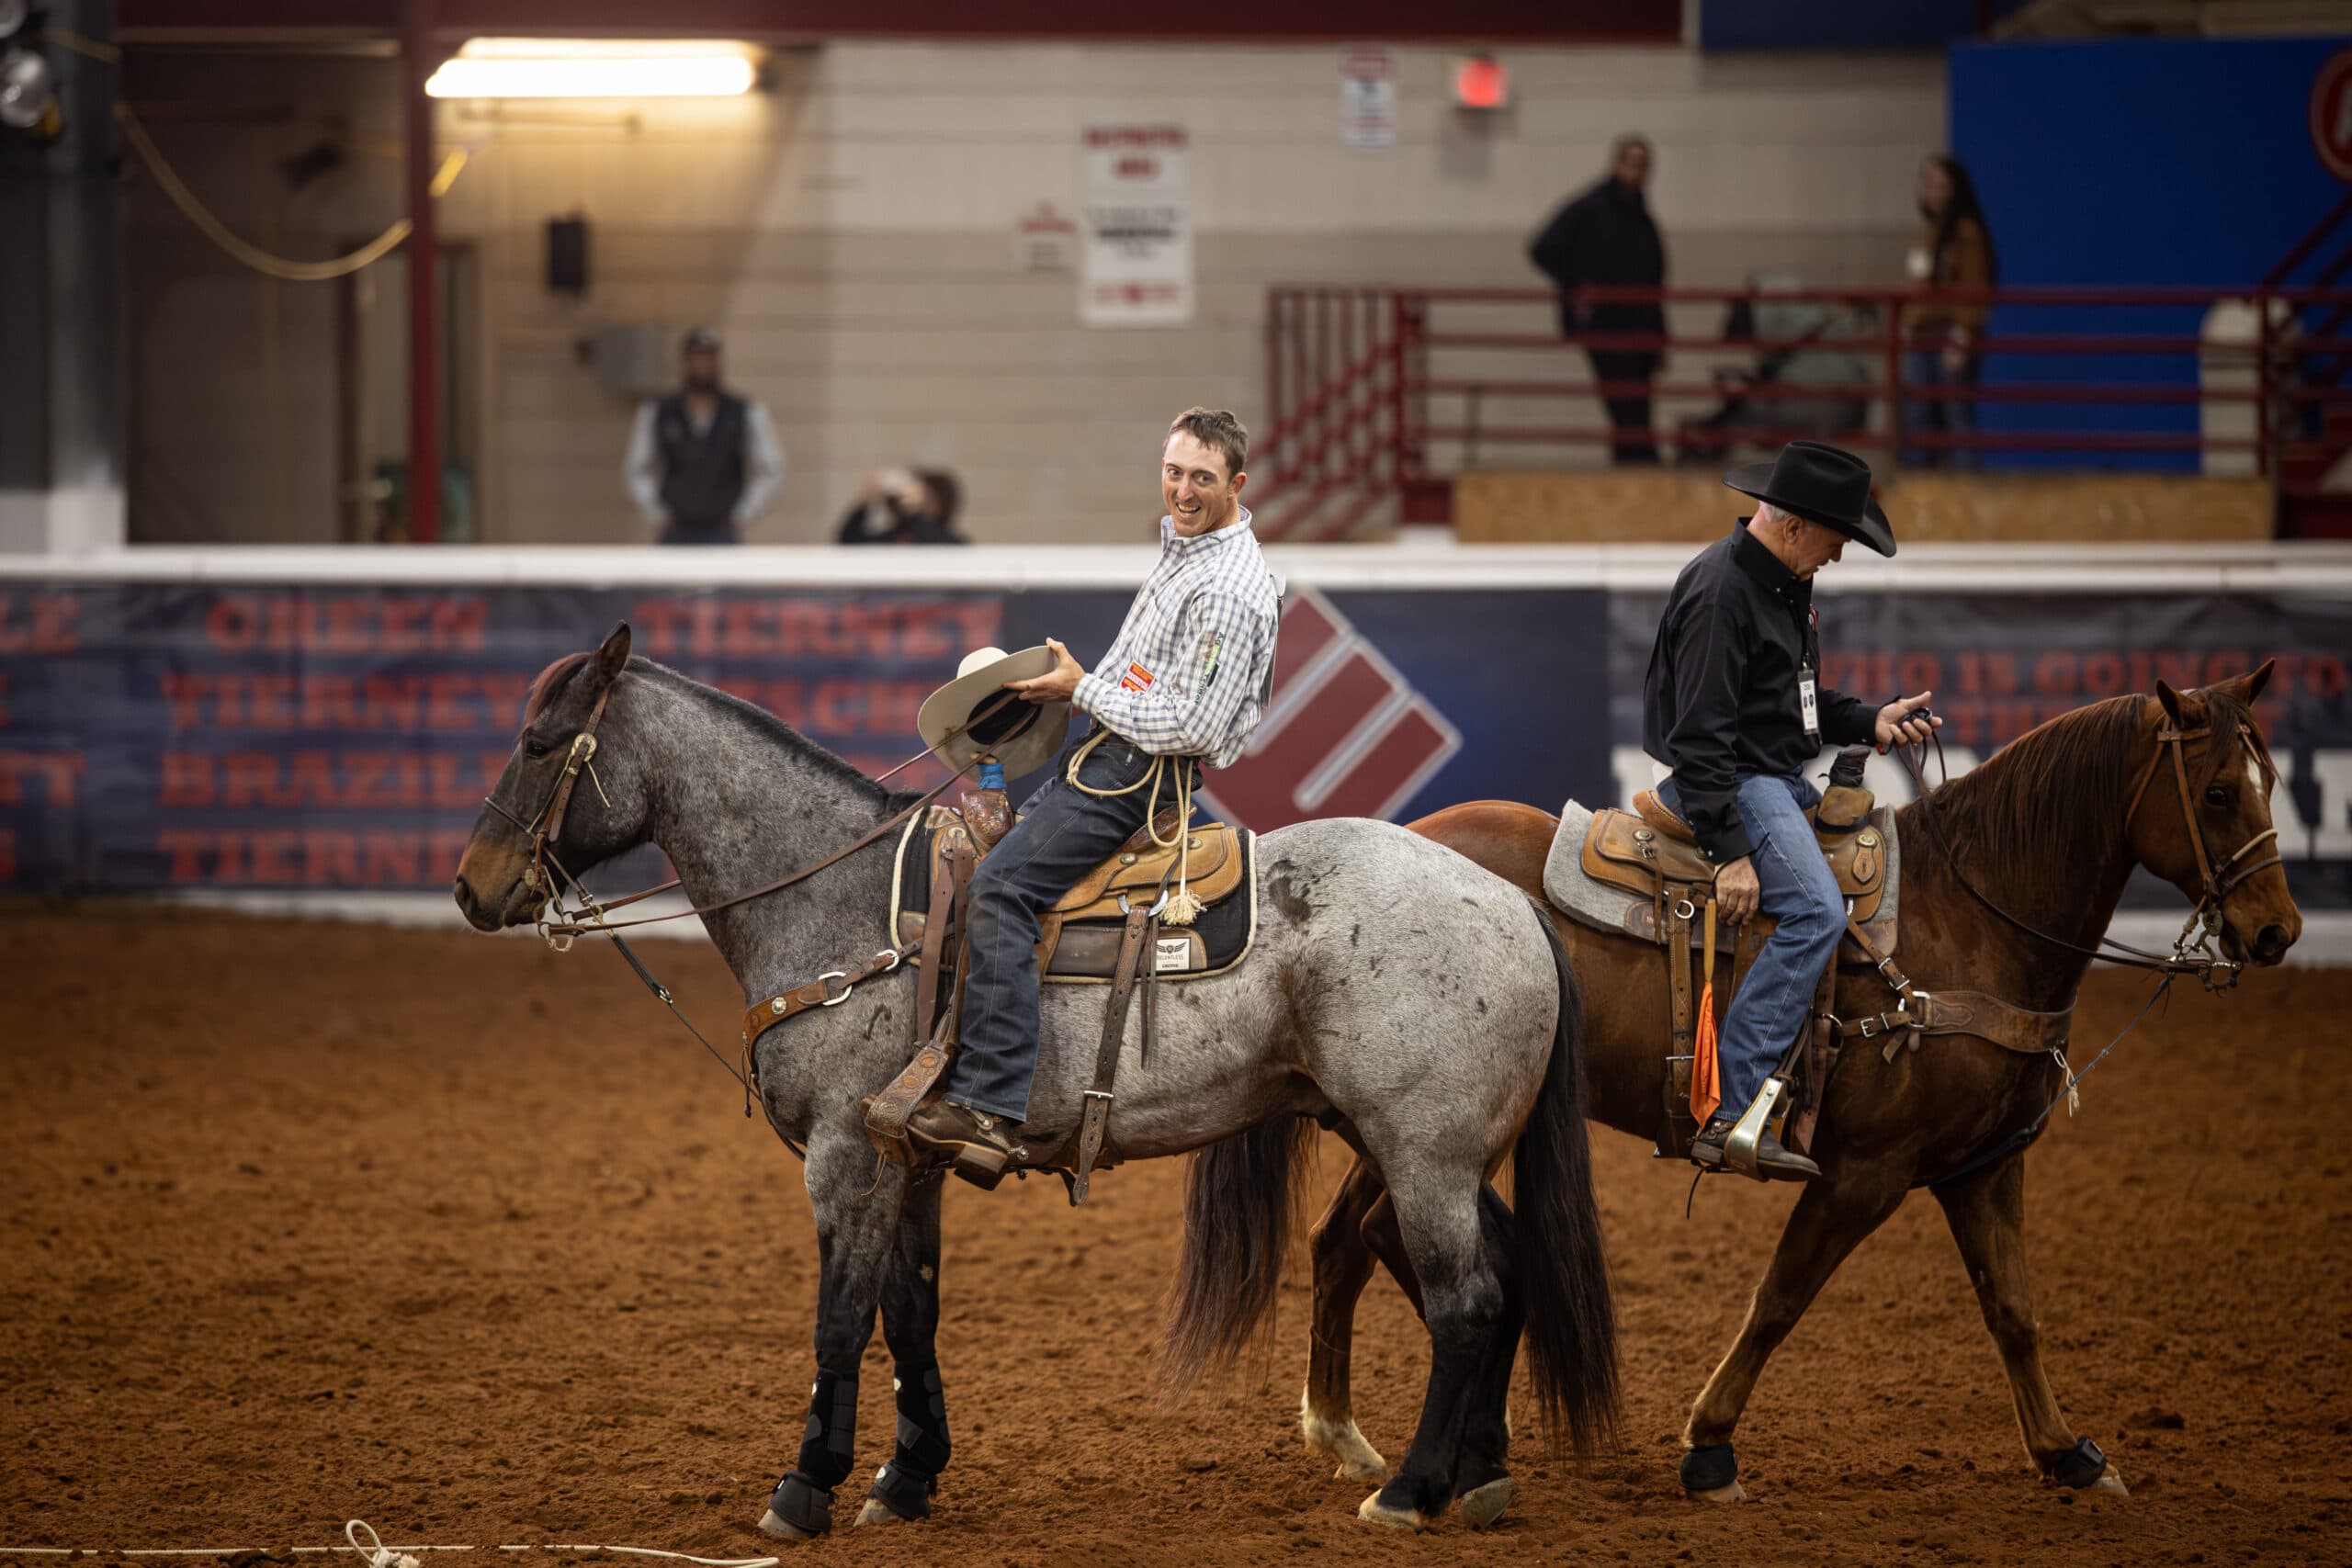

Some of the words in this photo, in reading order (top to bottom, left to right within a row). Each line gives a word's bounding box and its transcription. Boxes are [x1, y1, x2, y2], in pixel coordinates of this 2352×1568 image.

[205, 596, 489, 653] GREEN
[634, 599, 1004, 657] TIERNEY
[157, 672, 528, 730] TIERNEY
[155, 829, 470, 884] TIERNE
